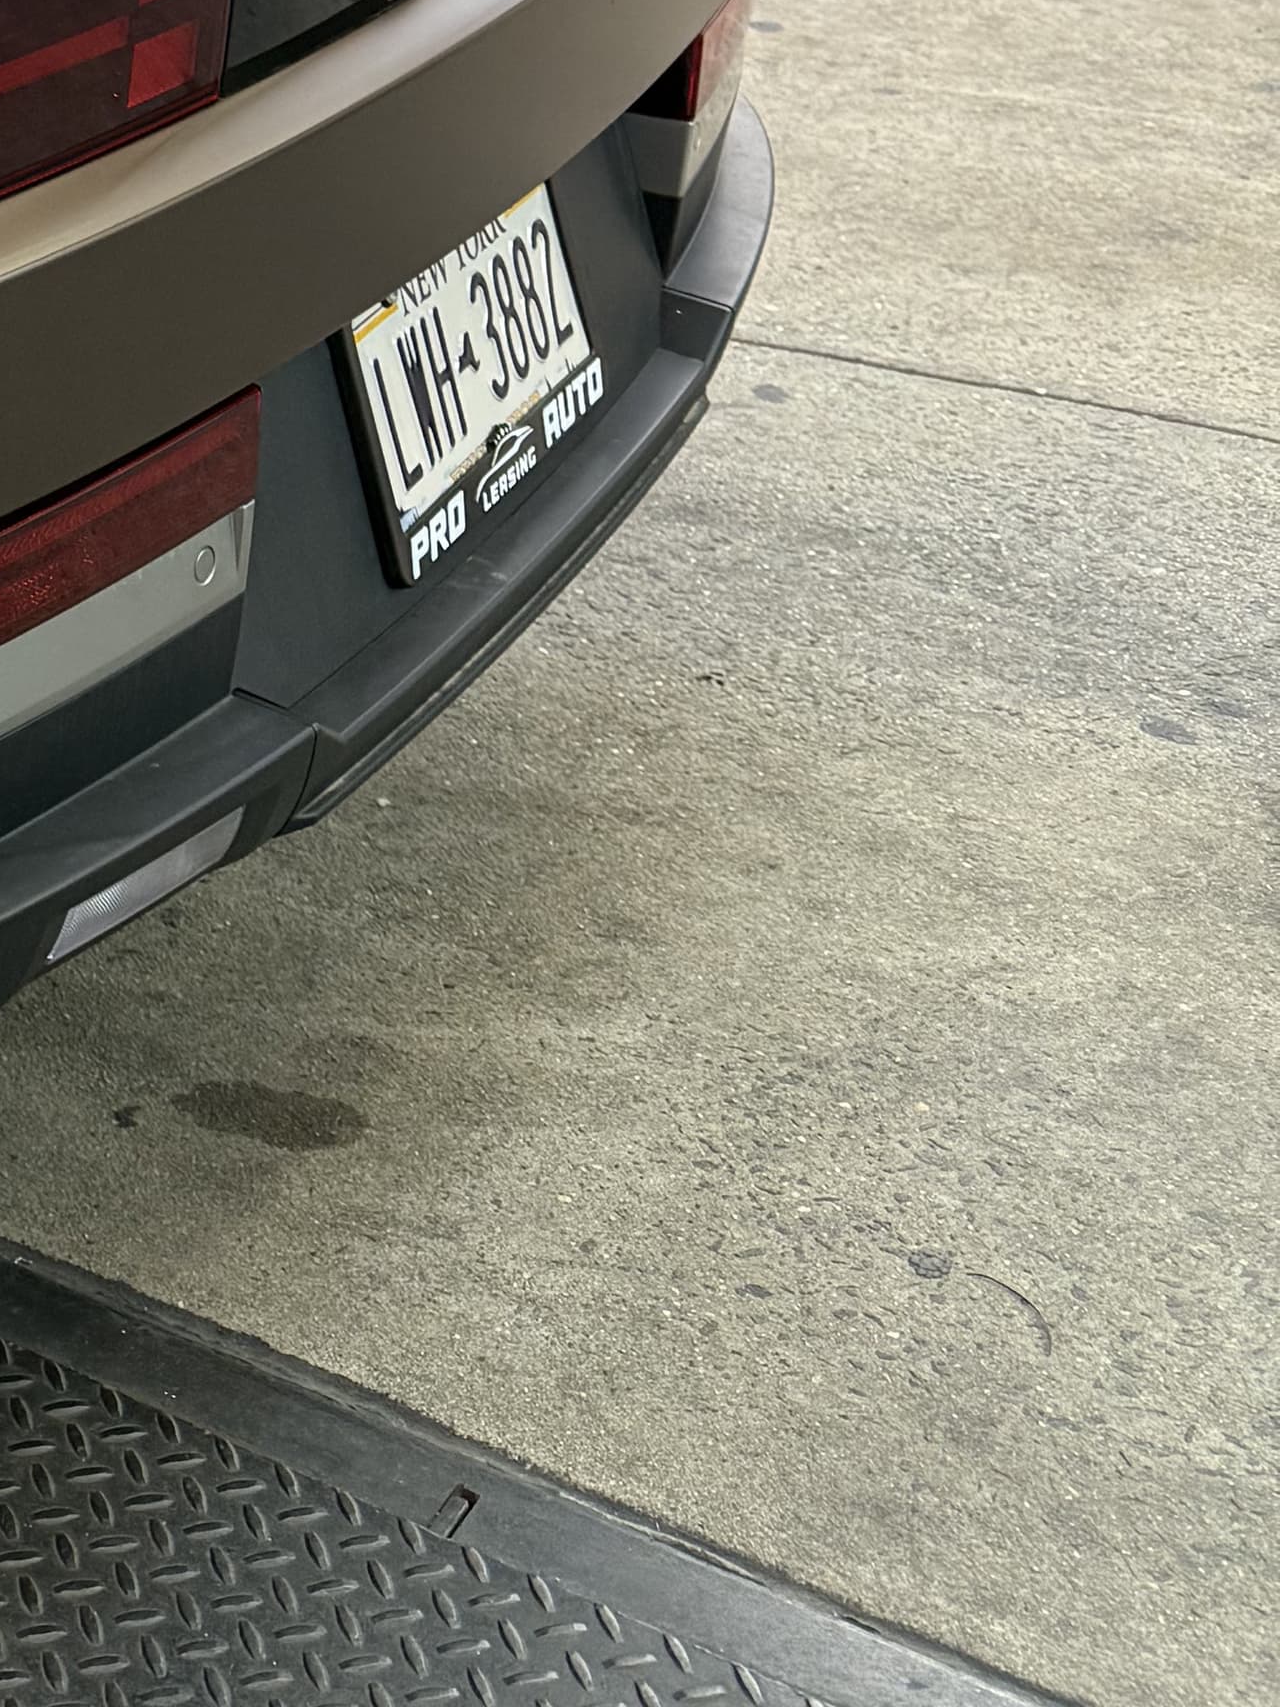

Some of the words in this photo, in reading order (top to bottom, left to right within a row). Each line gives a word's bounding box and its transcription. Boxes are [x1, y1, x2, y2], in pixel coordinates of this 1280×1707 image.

[400, 259, 448, 317] NEW
[470, 218, 574, 400] 3882
[410, 489, 466, 579] PRO
[482, 446, 537, 512] LEASING
[542, 356, 603, 448] AUTO
